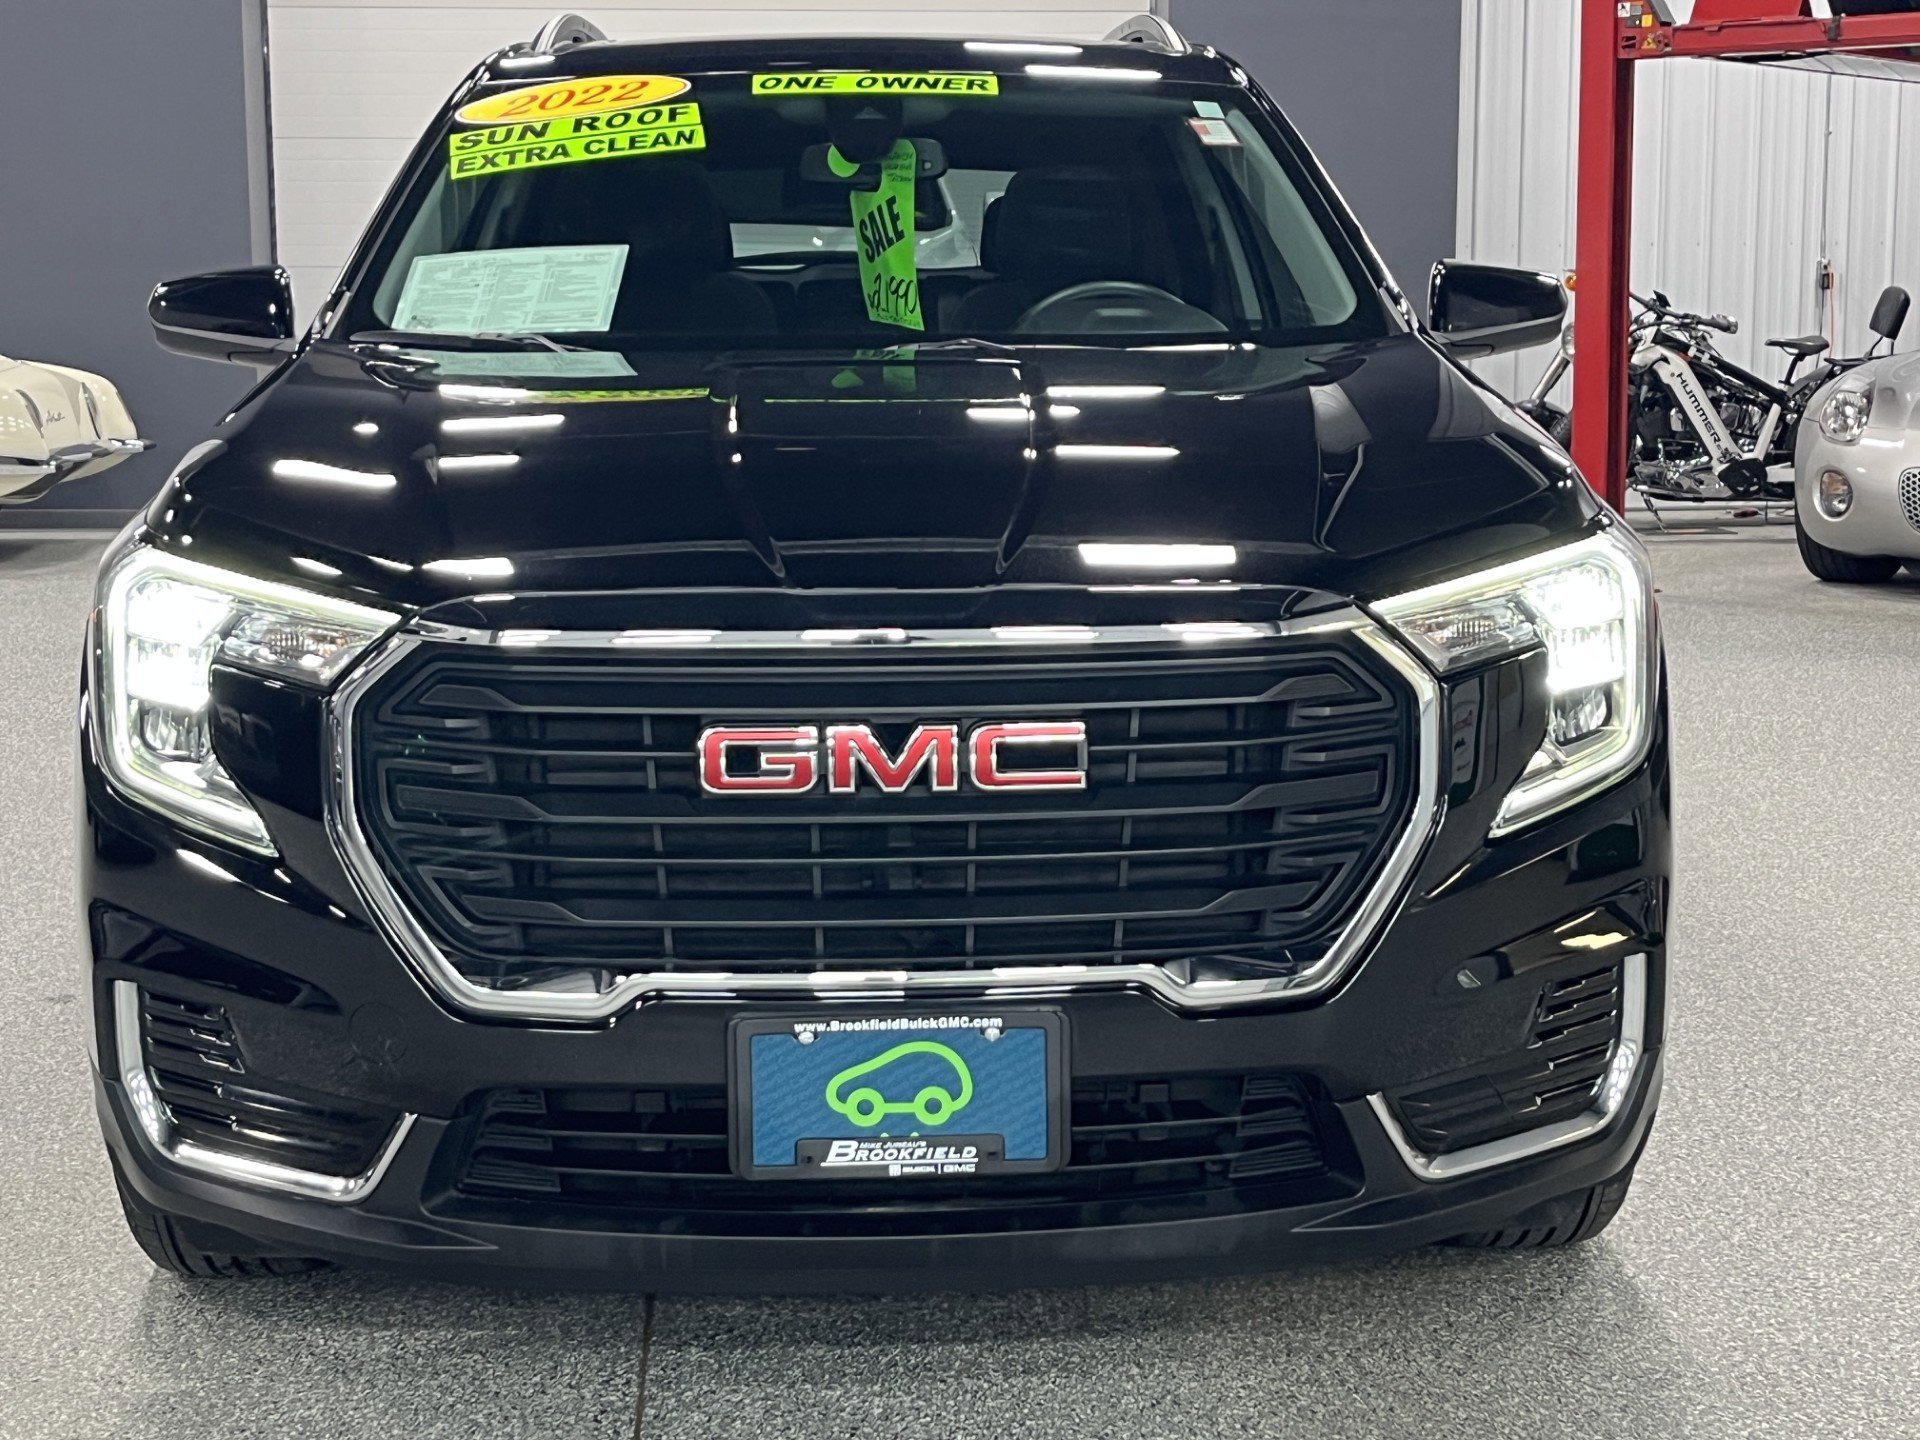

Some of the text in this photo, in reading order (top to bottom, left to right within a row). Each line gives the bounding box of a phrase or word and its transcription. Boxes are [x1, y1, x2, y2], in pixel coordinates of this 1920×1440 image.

[497, 80, 650, 119] 2022
[759, 76, 991, 91] ONE OWNER
[455, 105, 691, 151] SUN ROOF
[456, 129, 696, 174] EXTRA CLEAN
[859, 194, 906, 264] SALE
[1676, 372, 1721, 444] HUMMER
[698, 721, 1088, 794] GMC
[793, 1016, 1003, 1033] www.BrookfieldBuickGMC.com
[826, 1140, 977, 1163] BROOKFIELD
